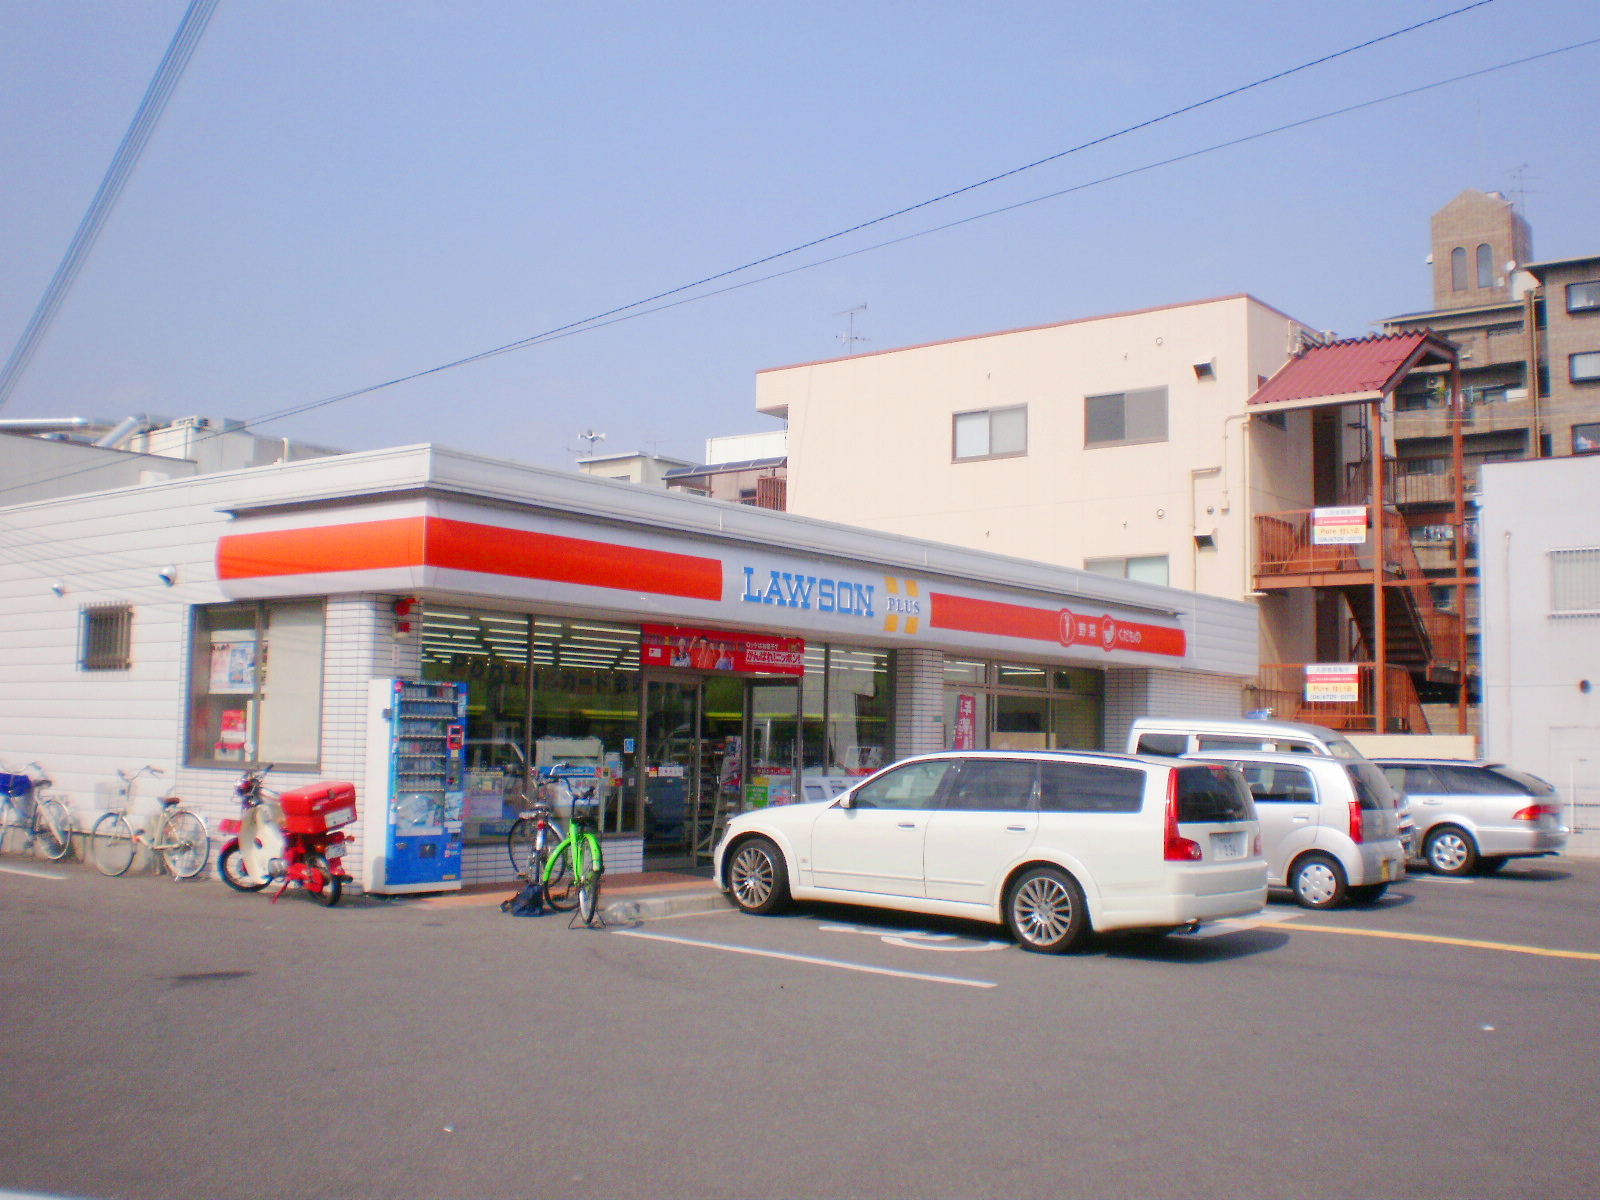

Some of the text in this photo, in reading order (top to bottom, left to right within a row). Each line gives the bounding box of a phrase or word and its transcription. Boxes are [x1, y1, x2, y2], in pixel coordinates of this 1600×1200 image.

[742, 567, 920, 617] LAWSON PLUS
[1078, 623, 1142, 643] 野菜 くだもの
